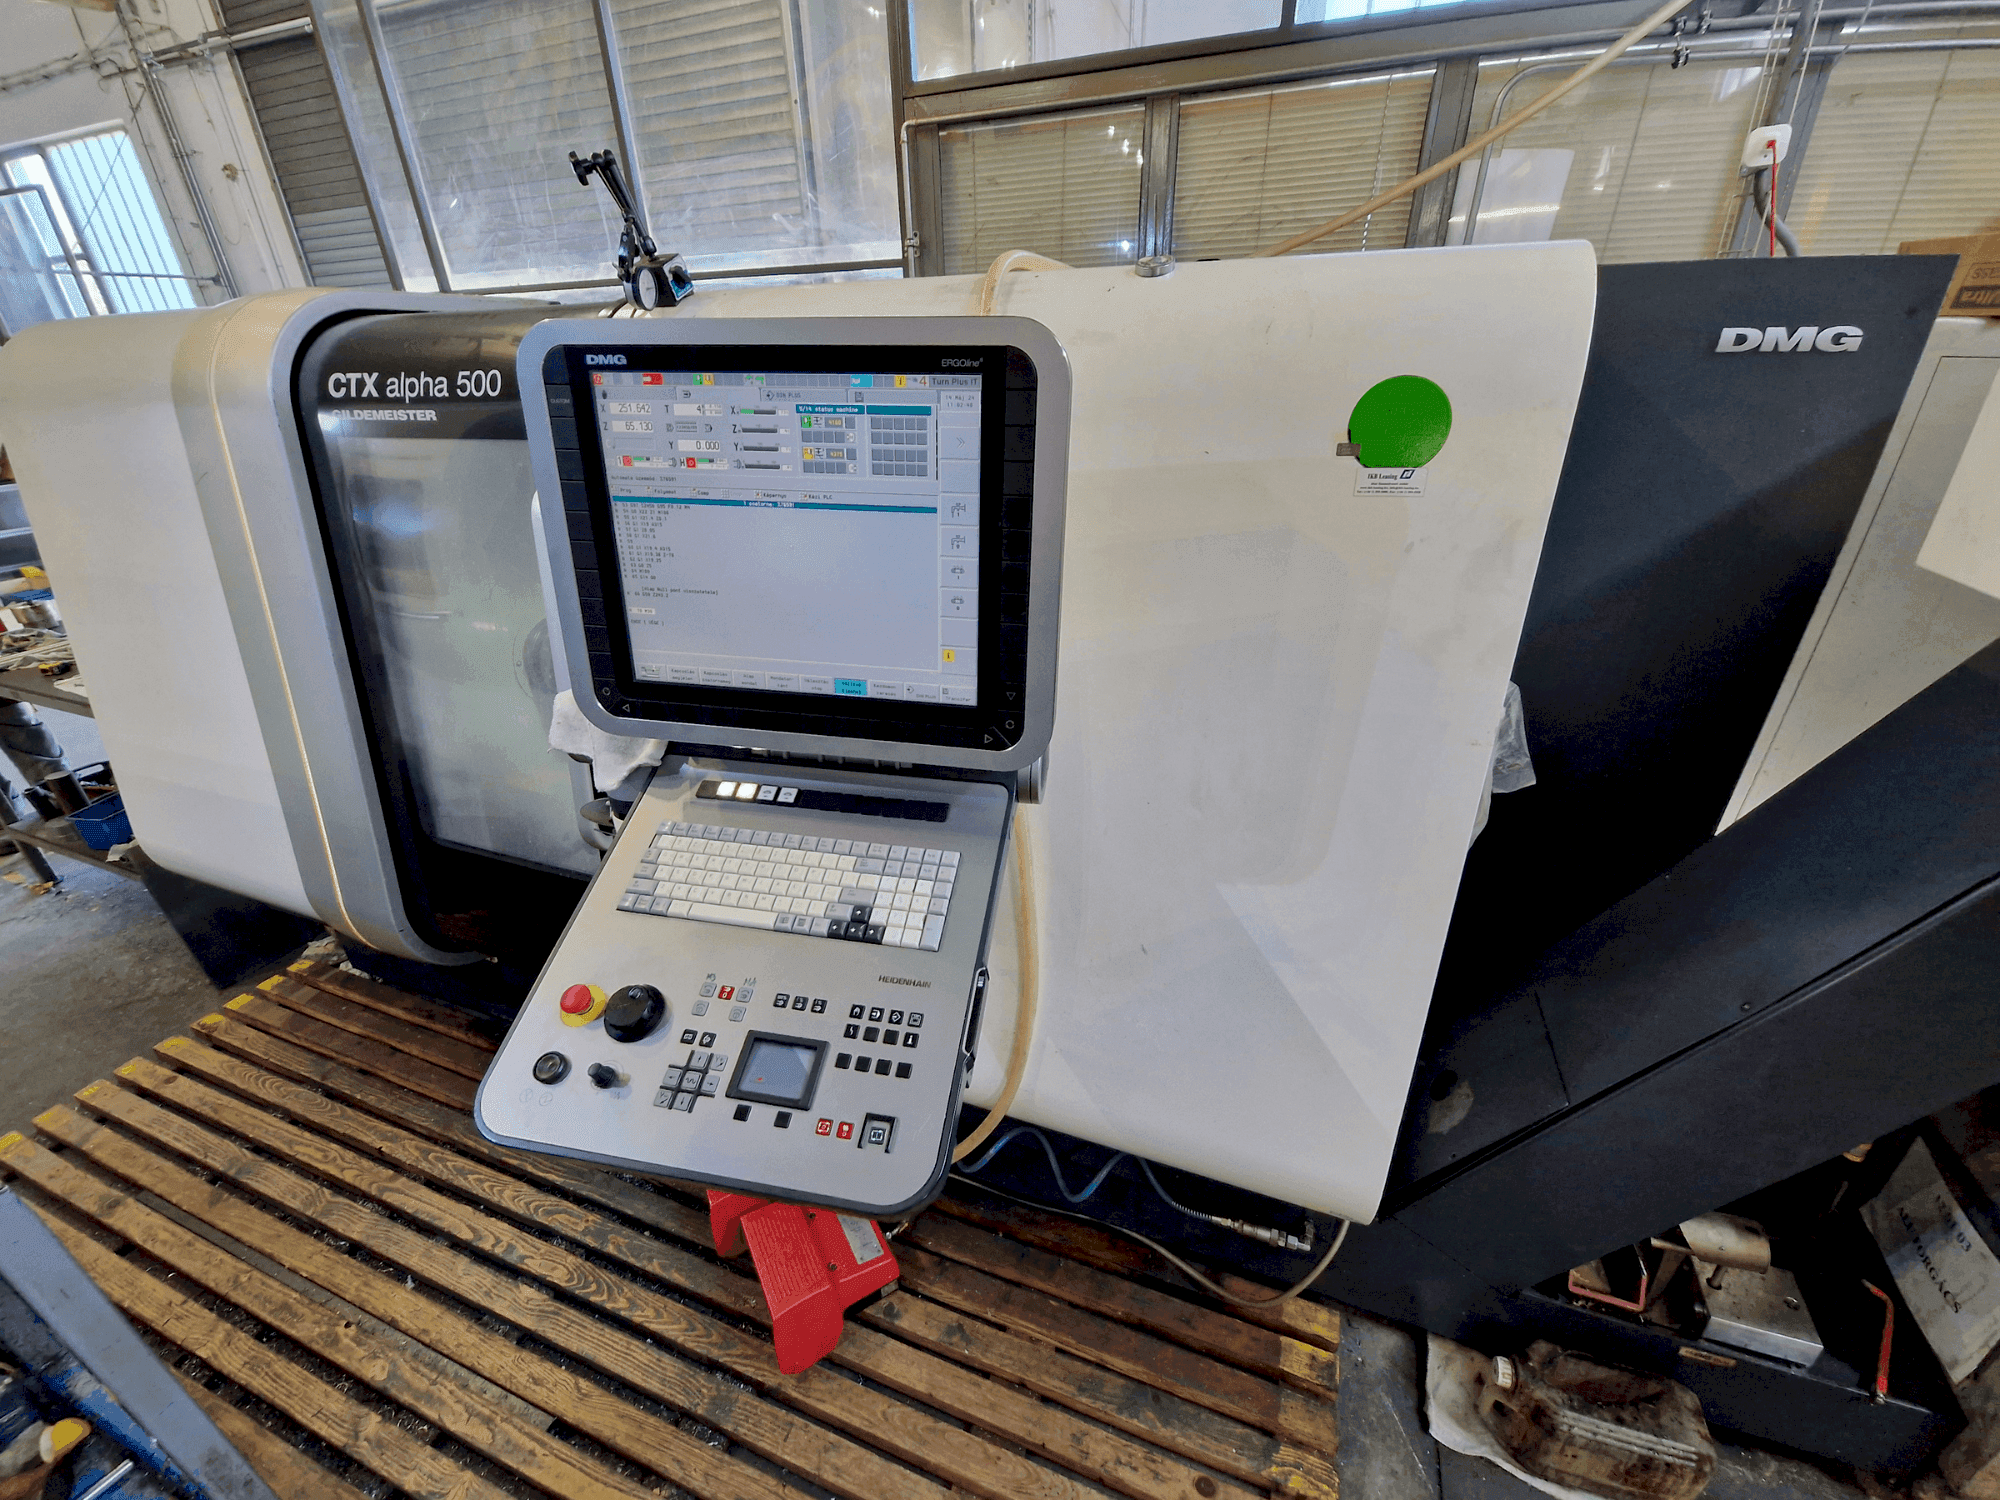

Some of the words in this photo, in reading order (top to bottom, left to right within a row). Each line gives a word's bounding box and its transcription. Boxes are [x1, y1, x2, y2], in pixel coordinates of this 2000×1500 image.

[1715, 325, 1864, 353] DMG
[585, 354, 628, 365] DMG
[328, 372, 379, 399] CTX
[386, 370, 449, 404] alpha
[456, 369, 502, 397] 500
[932, 378, 950, 386] Turn
[952, 378, 968, 386] Plus
[600, 404, 606, 412] X
[618, 404, 650, 413] 251.642
[664, 404, 670, 413] T
[730, 406, 736, 414] X
[332, 409, 438, 422] GILDEMEISTER
[603, 422, 608, 430] Z
[625, 422, 653, 431] 65.130
[732, 424, 738, 434] Z
[668, 440, 674, 450] Y
[696, 440, 720, 450] 0.000
[734, 442, 739, 451] Y
[878, 974, 932, 988] HEIDENHAIN
